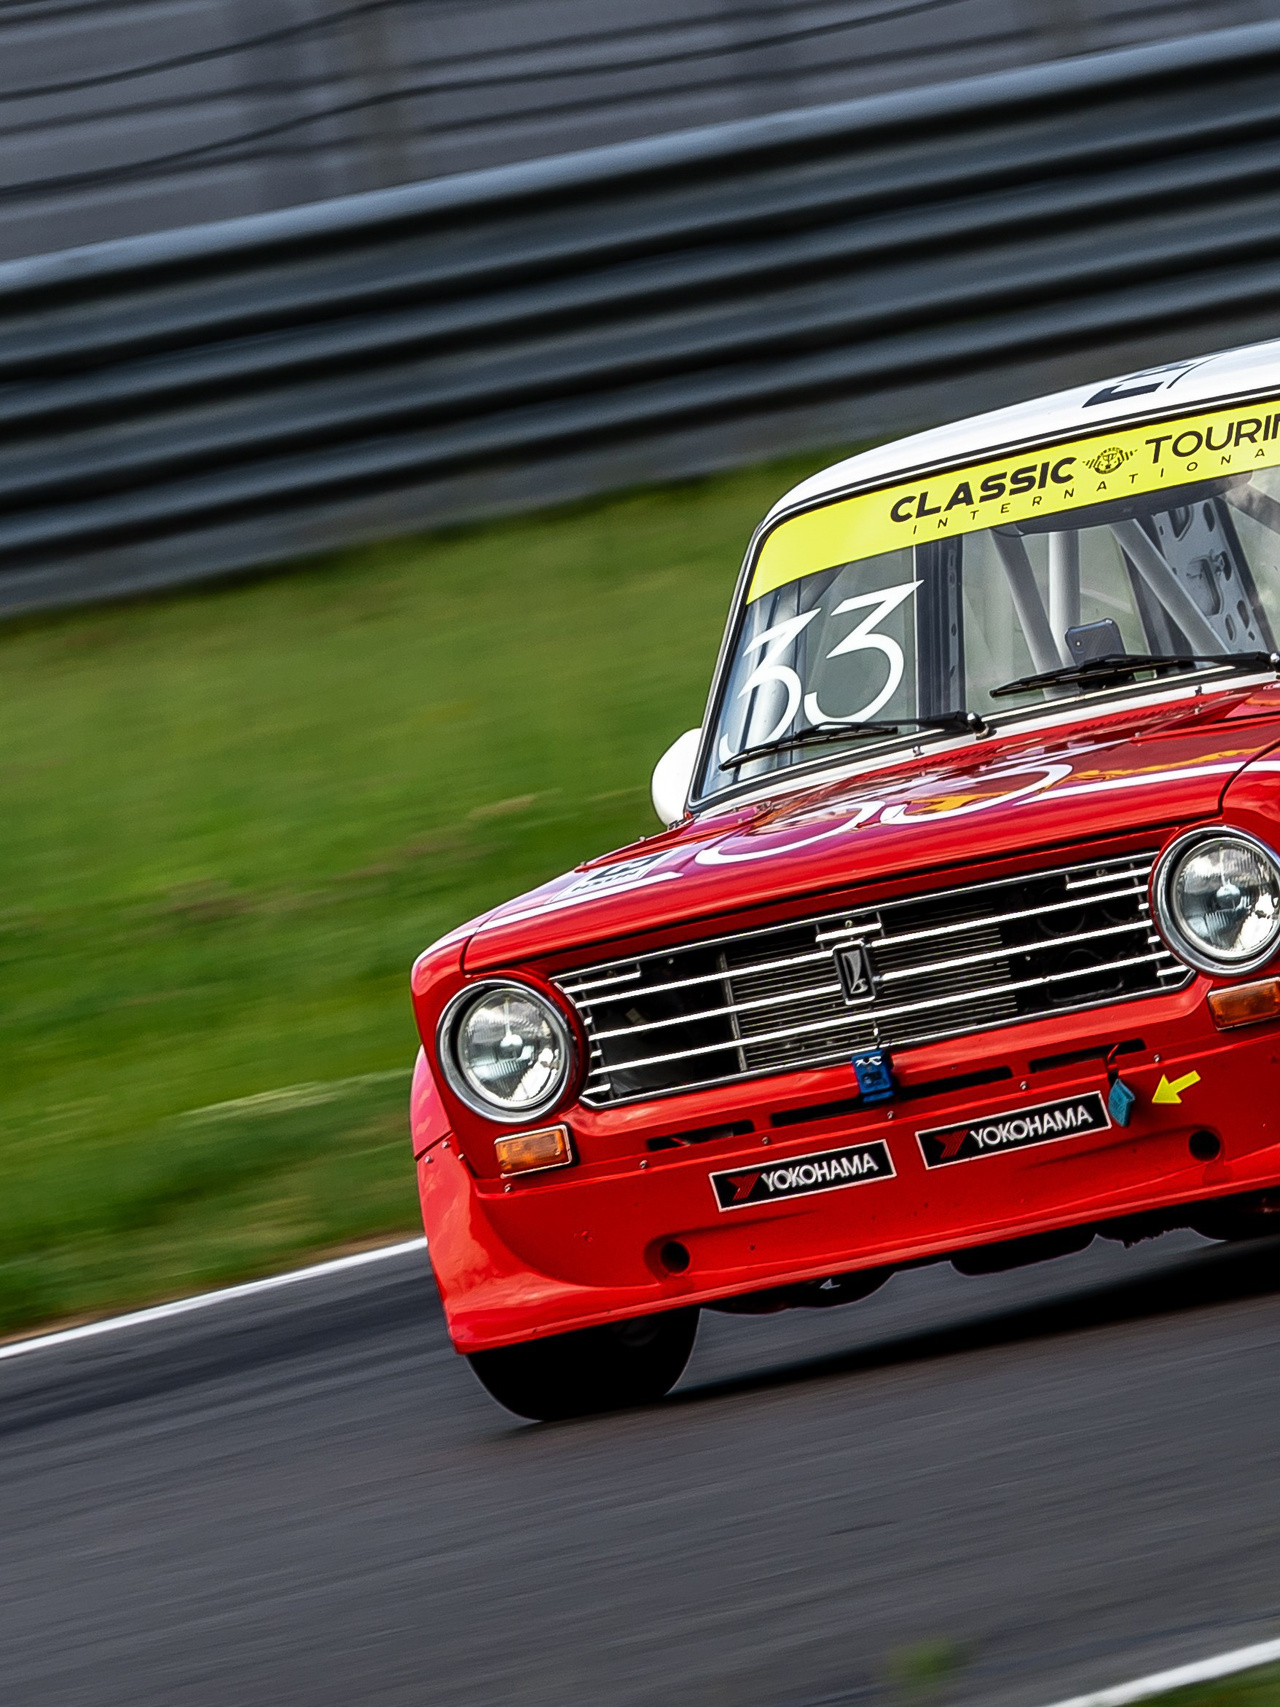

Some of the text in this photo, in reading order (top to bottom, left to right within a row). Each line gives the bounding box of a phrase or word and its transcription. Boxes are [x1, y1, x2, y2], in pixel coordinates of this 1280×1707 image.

[889, 456, 1077, 523] CLASSIC
[718, 579, 925, 767] 33
[969, 1104, 1093, 1149] YOKOHAMA
[760, 1151, 879, 1192] YOKOHAMA
